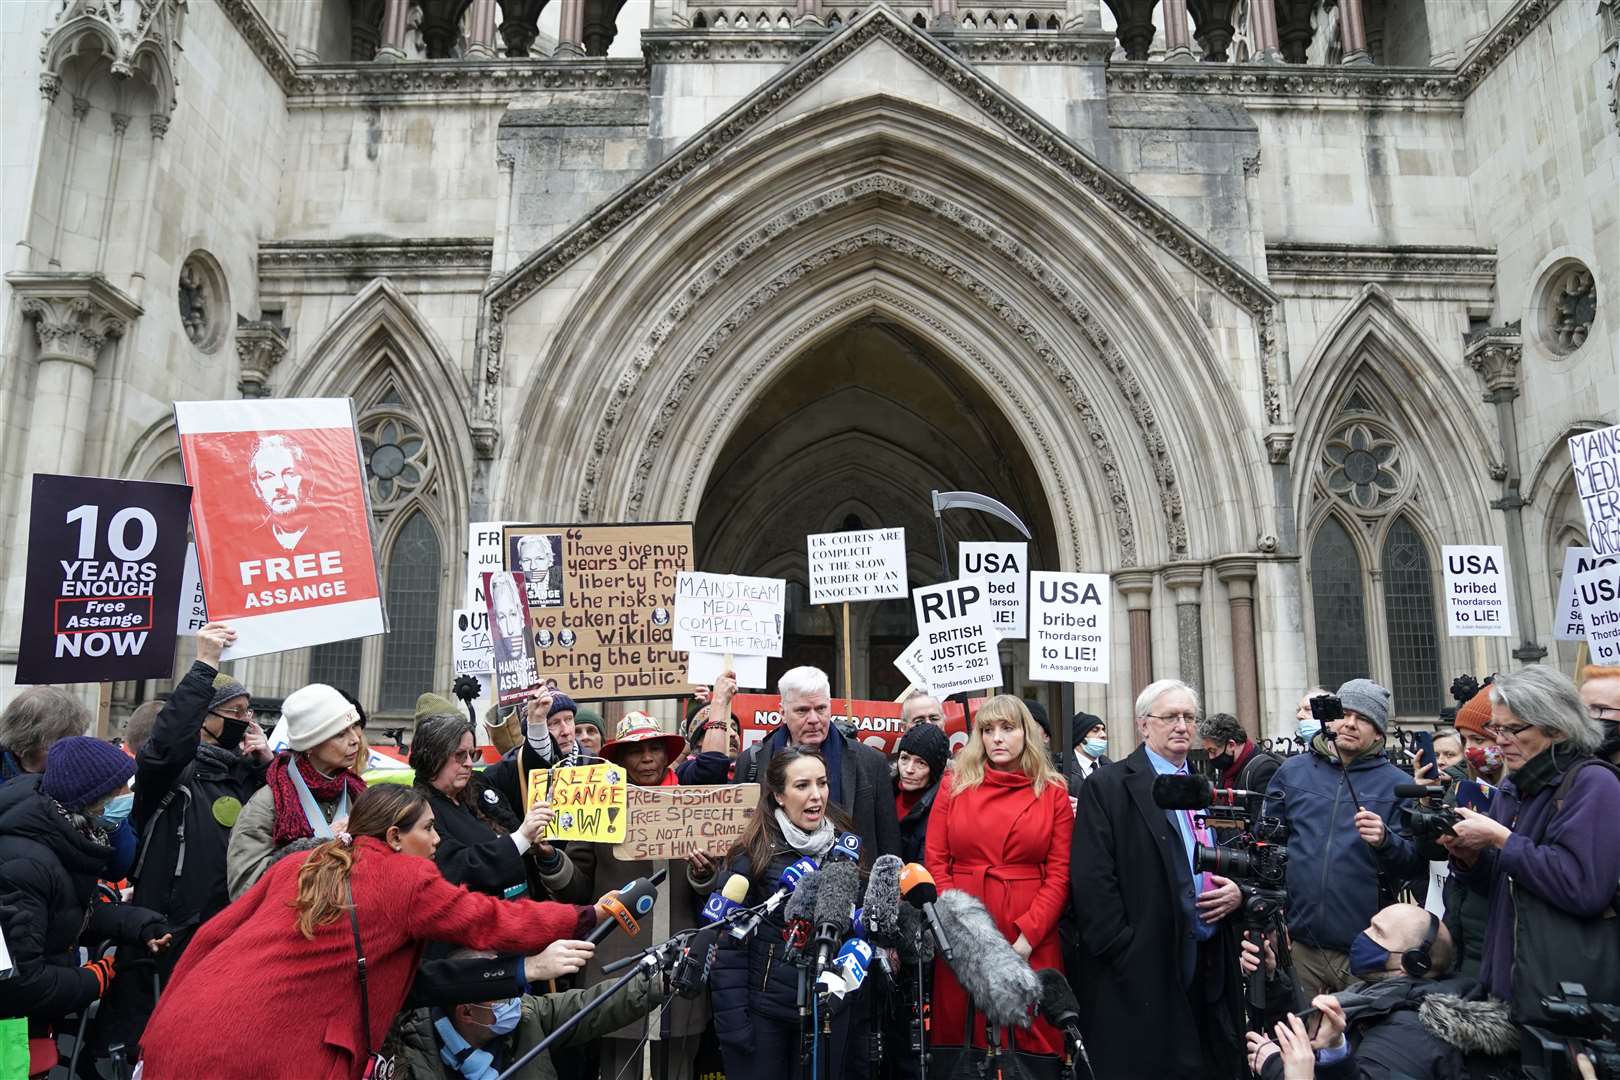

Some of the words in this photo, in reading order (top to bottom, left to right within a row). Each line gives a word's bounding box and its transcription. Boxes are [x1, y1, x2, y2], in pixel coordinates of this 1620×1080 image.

[65, 504, 158, 562] 10
[812, 538, 827, 547] UK
[832, 534, 874, 545] COURTS
[879, 531, 901, 541] ARE
[575, 541, 613, 556] have
[618, 541, 664, 561] given
[667, 544, 688, 560] up
[812, 546, 872, 560] COMPLICIT
[60, 560, 157, 582] YEARS
[239, 550, 344, 586] FREE
[567, 558, 617, 577] years
[628, 554, 648, 571] of
[813, 563, 824, 572] IN
[829, 561, 850, 571] THE
[855, 558, 886, 569] SLOW
[965, 552, 1020, 574] USA
[1448, 555, 1500, 575] USA
[579, 572, 646, 594] liberty
[814, 573, 859, 585] MURDER
[864, 572, 879, 581] OF
[884, 570, 899, 580] AN
[61, 580, 154, 597] ENOUGH
[244, 580, 348, 609] ASSANGE
[679, 577, 779, 602] MAINSTREAM
[814, 586, 869, 599] INNOCENT
[874, 584, 899, 594] MAN
[1040, 580, 1102, 606] USA
[1454, 582, 1497, 594] bribed
[1581, 576, 1620, 605] US
[85, 600, 126, 614] Free
[570, 591, 602, 608] the
[608, 590, 657, 608] risks
[703, 599, 753, 616] MEDIA
[920, 585, 981, 624] RIP
[1451, 597, 1502, 606] Thordarson
[65, 613, 143, 629] Assange
[531, 616, 556, 628] ve
[561, 609, 614, 628] taken
[618, 609, 639, 625] at
[992, 610, 1015, 623] IE!
[1043, 612, 1096, 628] bribed
[1455, 610, 1470, 621] to
[1474, 609, 1500, 622] LIE!
[1591, 610, 1620, 627] brib
[691, 635, 722, 648] TELL
[723, 636, 745, 647] THE
[747, 637, 778, 651] TRUTH
[929, 624, 983, 645] BRITISH
[1038, 630, 1102, 642] Thordarson
[54, 631, 149, 658] NOW
[930, 640, 987, 661] JUSTICE
[1042, 645, 1058, 659] to
[1064, 645, 1096, 661] LIE!
[1598, 645, 1613, 658] to
[542, 648, 600, 673] bring
[608, 647, 641, 665] the
[931, 662, 955, 674] 1215
[965, 657, 989, 669] 2021
[1050, 663, 1082, 673] Assange
[568, 670, 604, 690] the
[932, 678, 973, 691] Thordarson
[754, 711, 782, 725] NO
[627, 790, 661, 809] FREE
[672, 789, 743, 806] ASSANGE
[631, 810, 661, 826] FREE
[665, 806, 734, 826] SPEECH
[629, 828, 648, 842] IS
[656, 828, 683, 841] NOT
[686, 824, 693, 838] A
[701, 821, 745, 838] CRIME
[635, 842, 665, 859] SET
[671, 840, 698, 857] HIM
